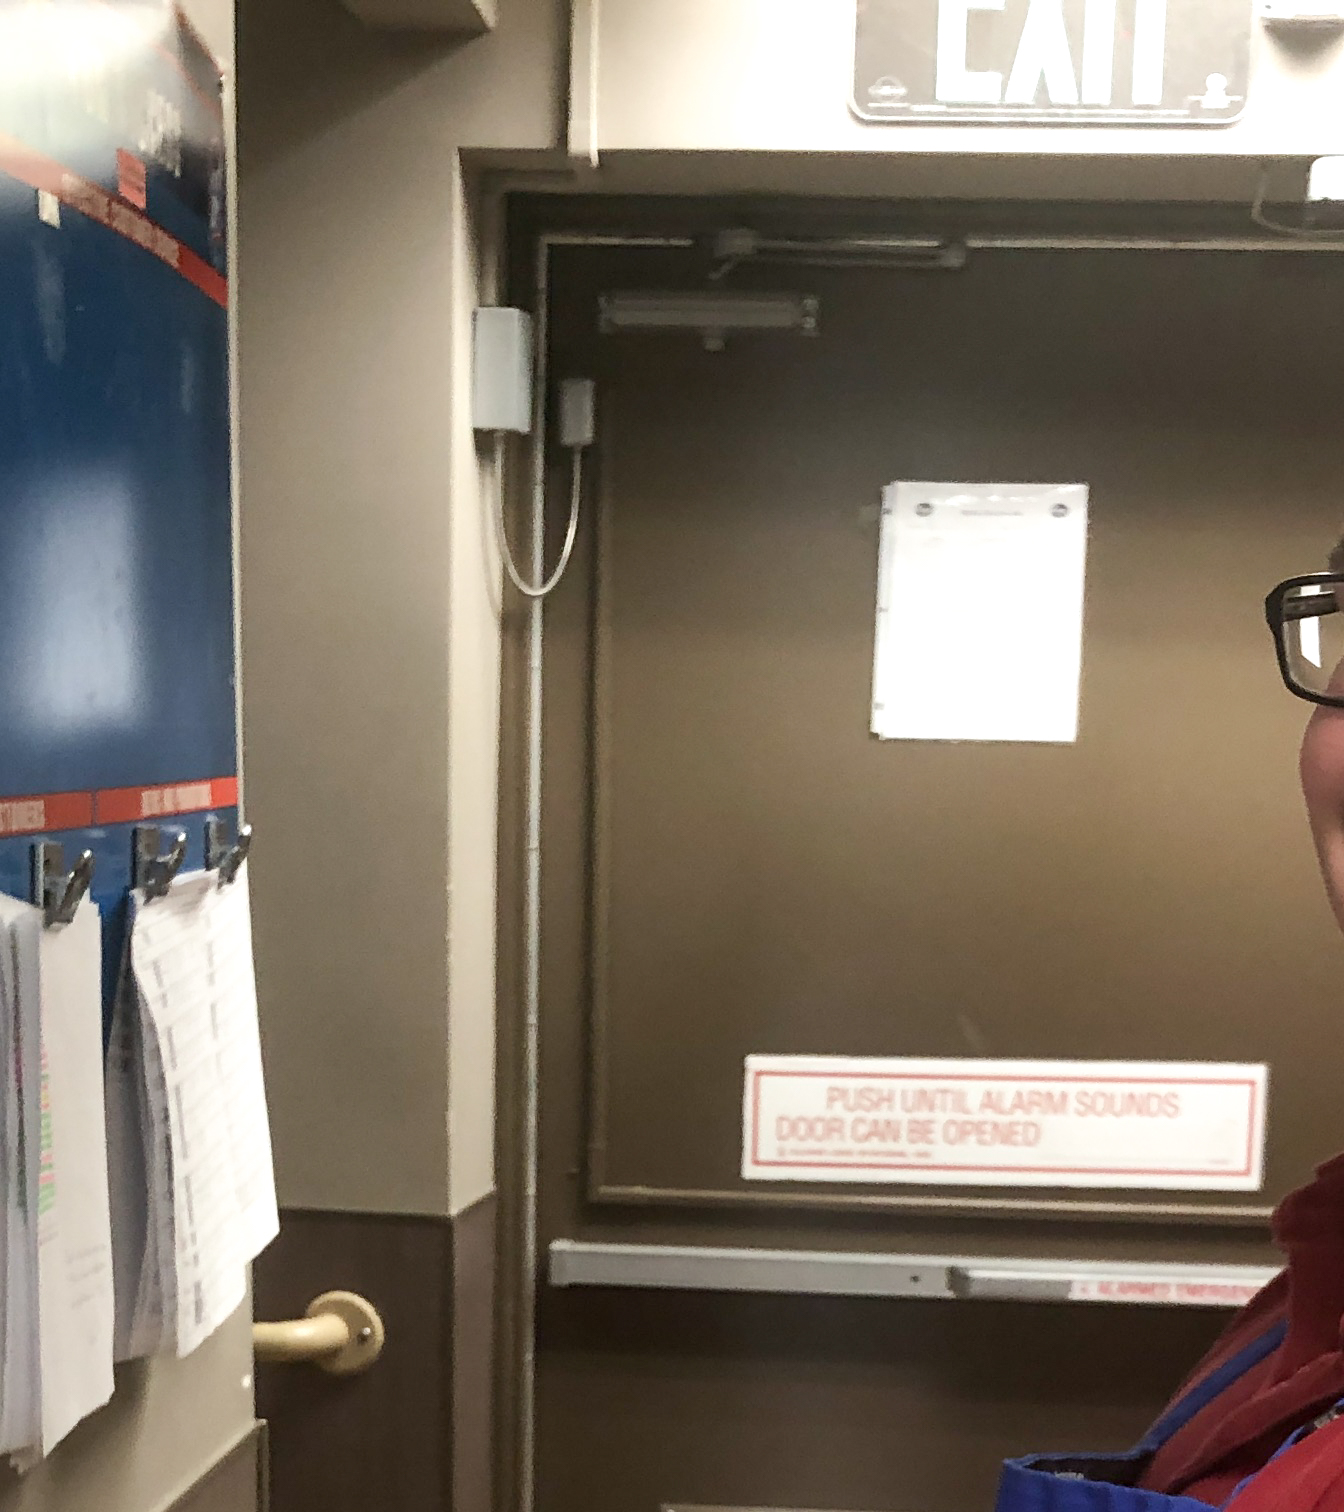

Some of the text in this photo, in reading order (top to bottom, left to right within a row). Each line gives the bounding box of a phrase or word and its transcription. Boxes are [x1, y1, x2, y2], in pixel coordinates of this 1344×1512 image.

[826, 1086, 1180, 1118] PUSH UNTIL ALARM SOUNDS
[776, 1116, 1040, 1147] DOOR CAN BE OPENED
